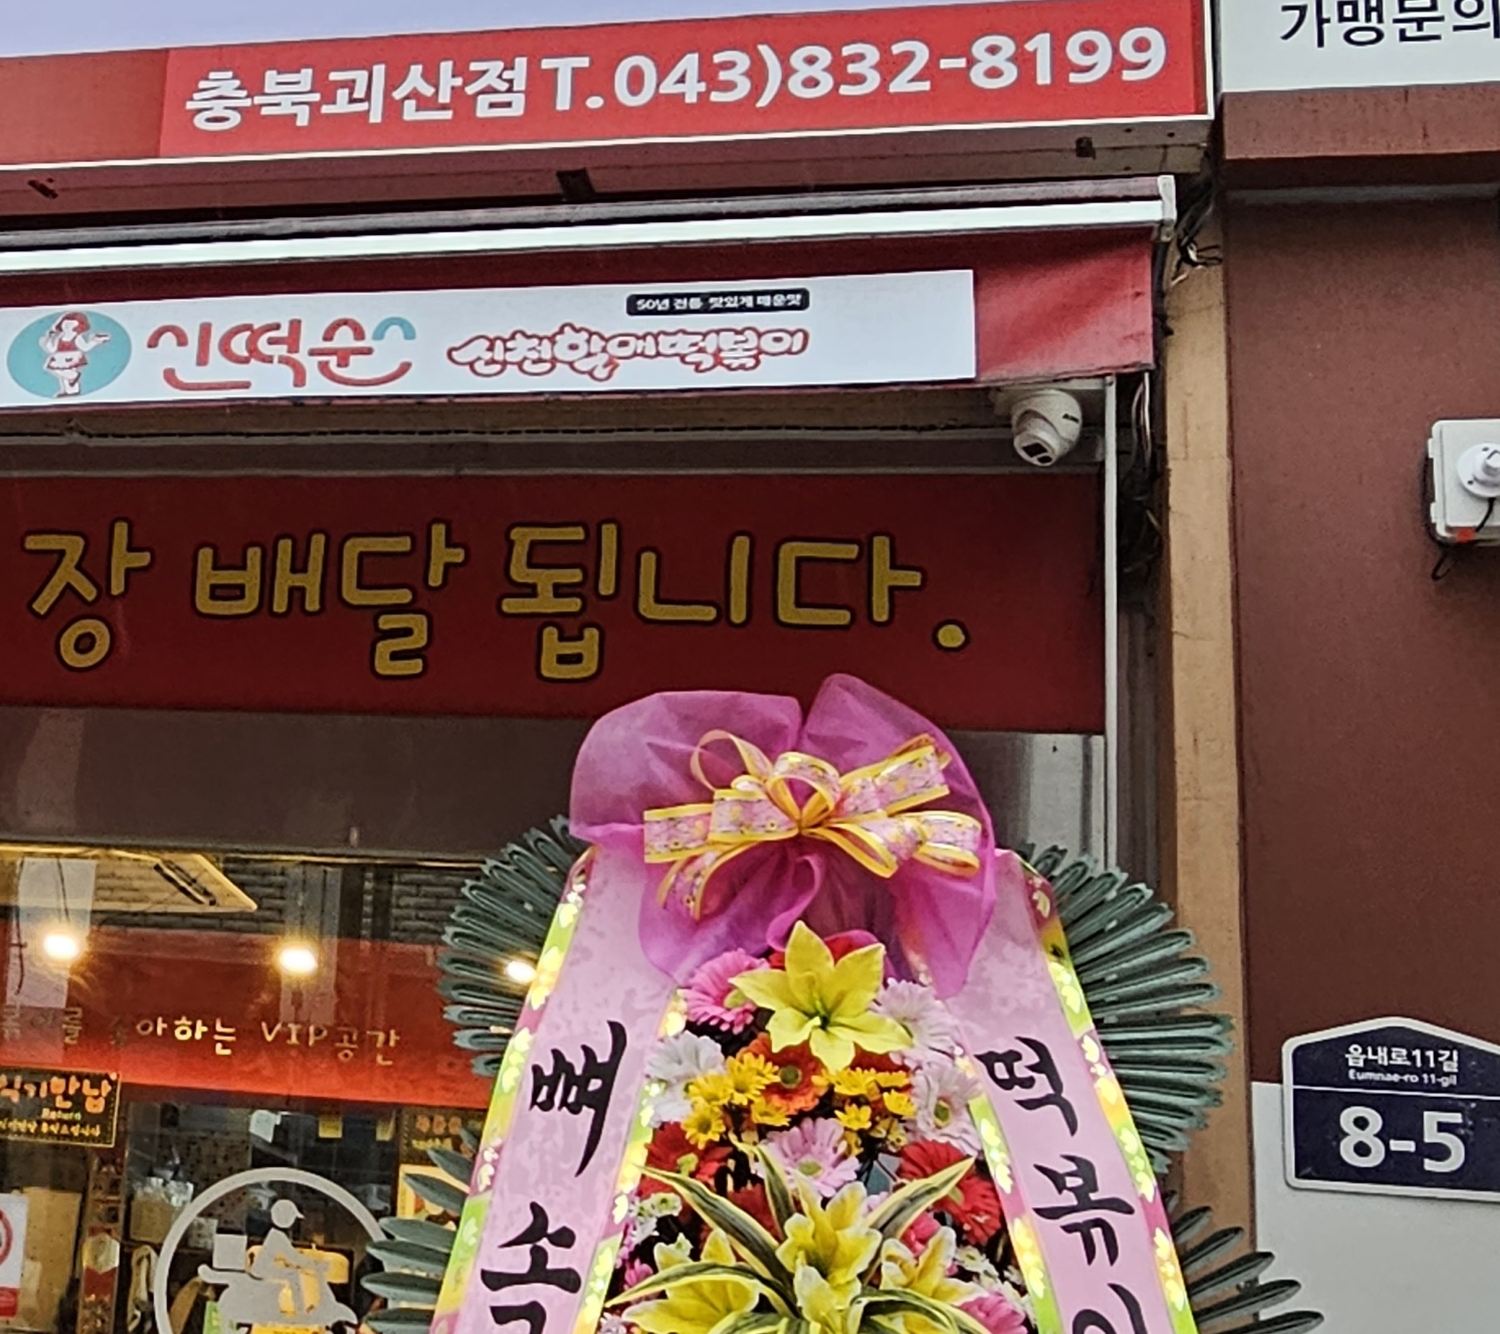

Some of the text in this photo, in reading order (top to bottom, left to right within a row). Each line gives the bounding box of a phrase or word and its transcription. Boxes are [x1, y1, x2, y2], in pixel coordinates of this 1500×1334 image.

[184, 59, 528, 133] 충북괴산점
[447, 322, 810, 383] 신천할매떡볶이
[193, 520, 466, 676] 배달
[499, 520, 968, 680] 됩니다.
[1344, 1043, 1459, 1073] 읍내로11길
[1348, 1068, 1458, 1088] Eumnae-ro 11-gil
[1338, 1105, 1466, 1173] 8-5
